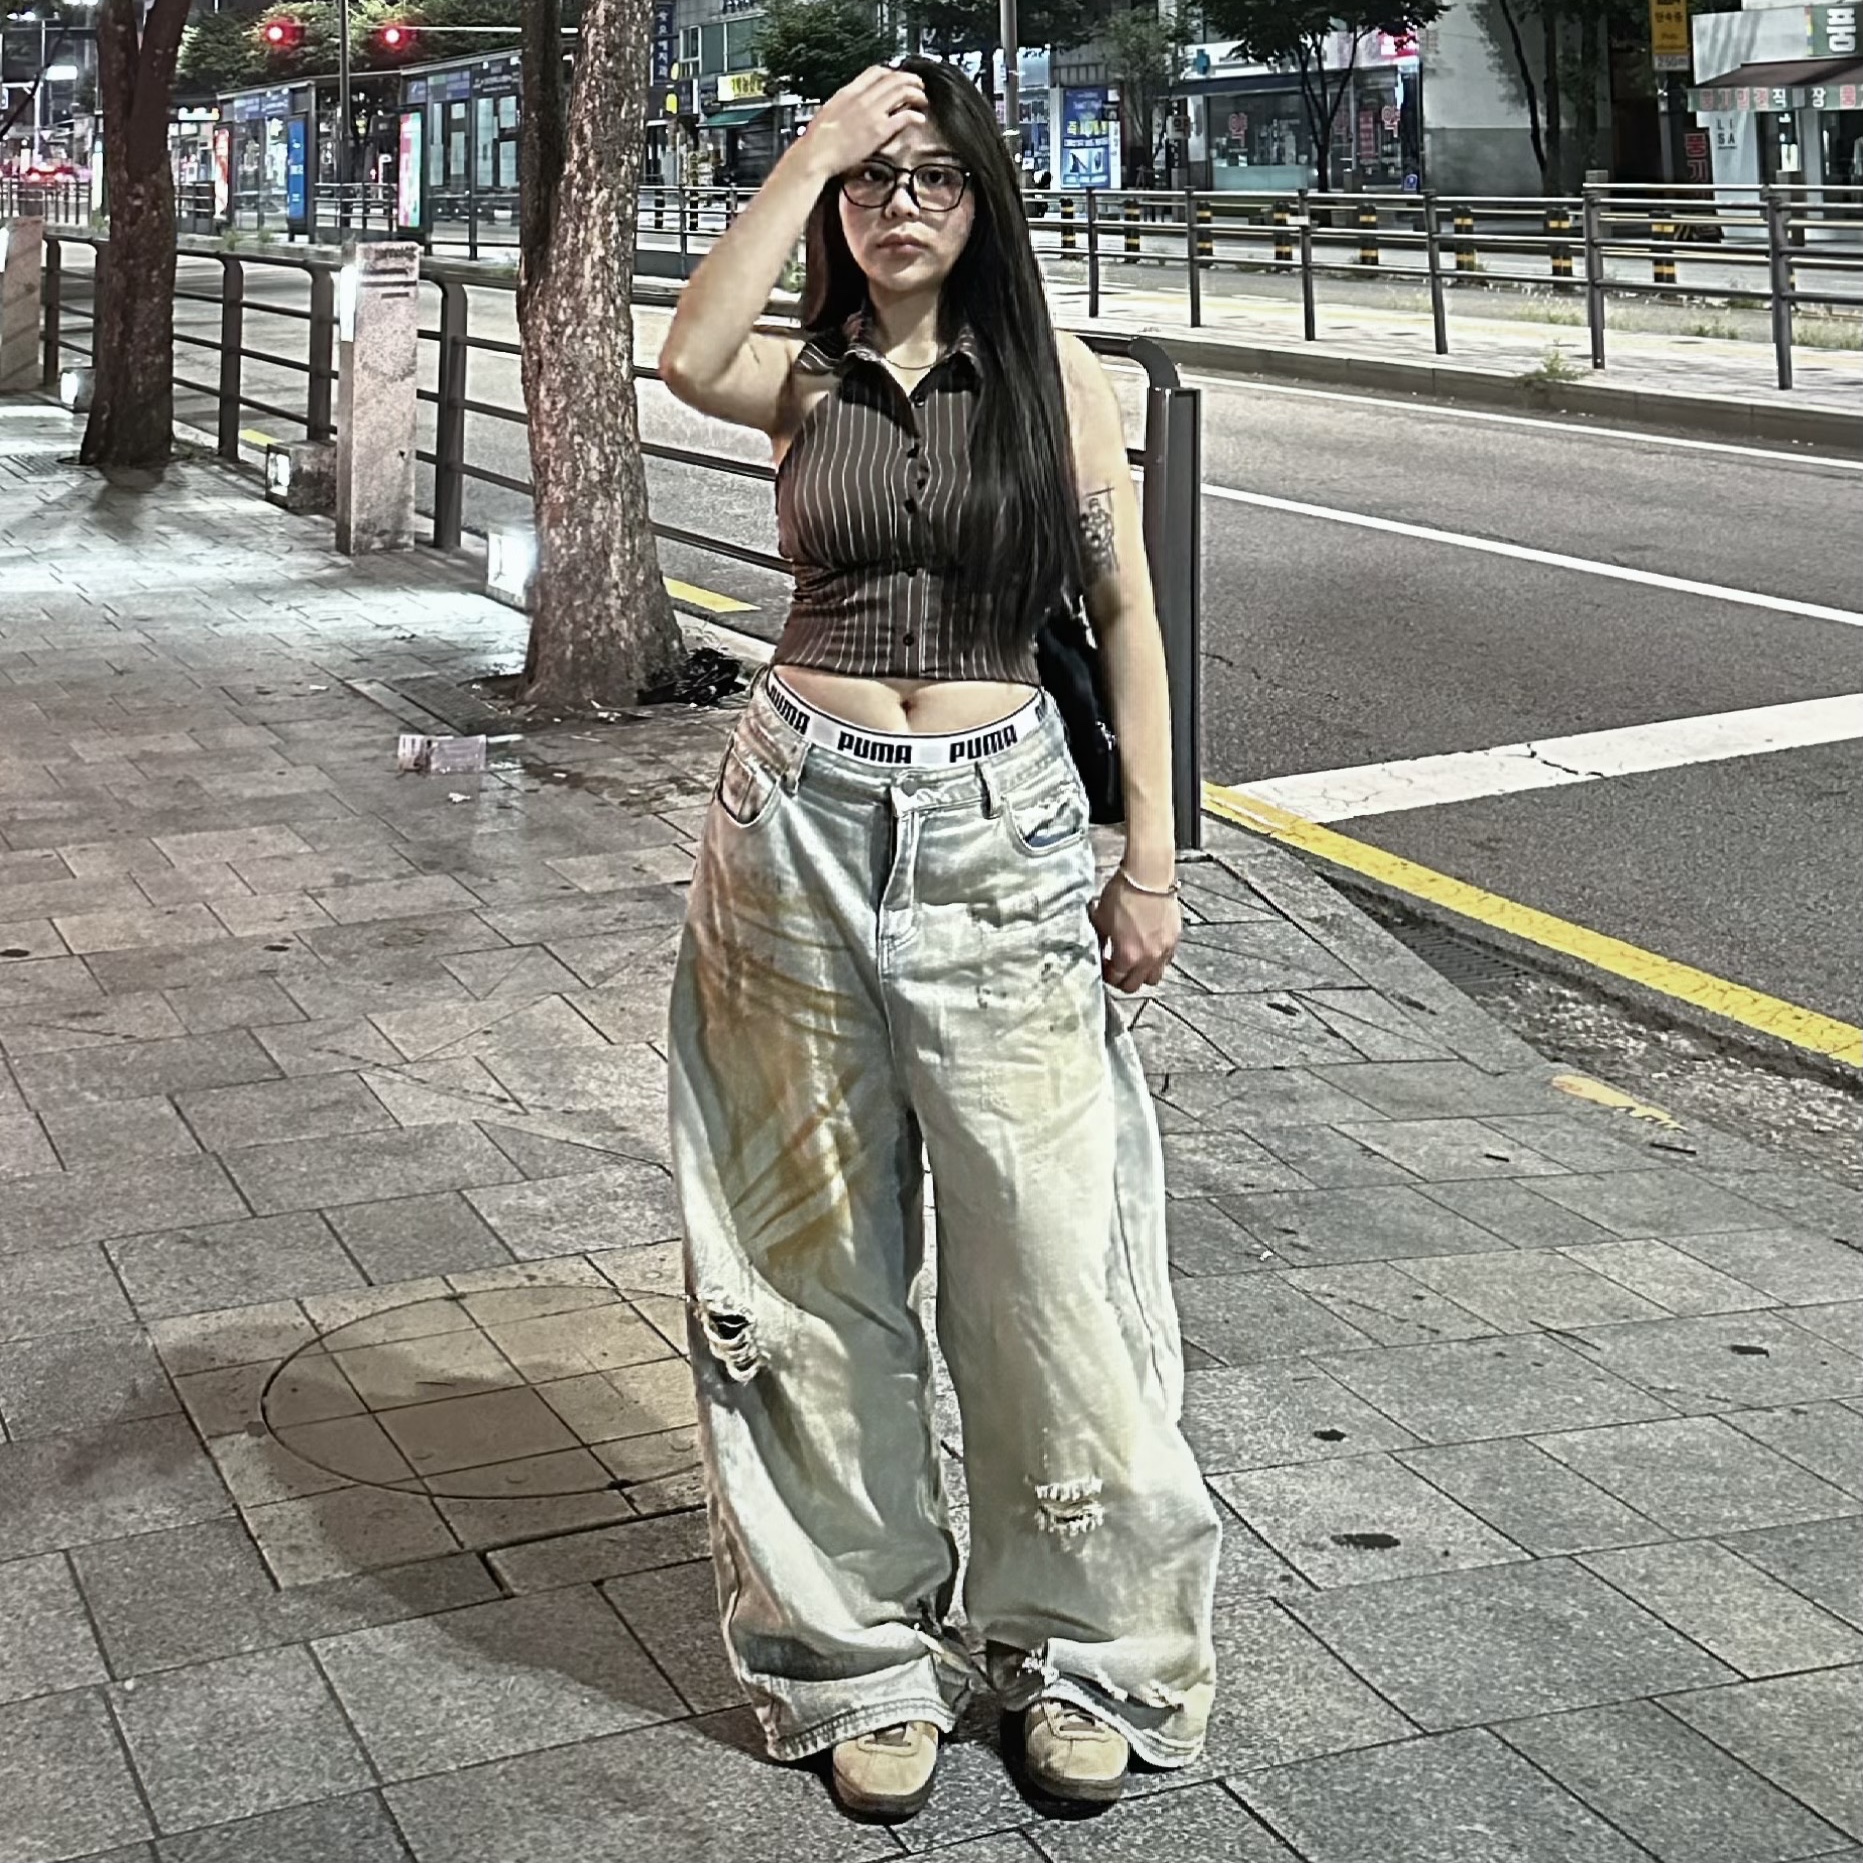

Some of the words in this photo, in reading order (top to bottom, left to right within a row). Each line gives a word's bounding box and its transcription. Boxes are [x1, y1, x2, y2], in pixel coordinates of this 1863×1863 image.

[769, 685, 811, 736] PUMA
[837, 731, 912, 764] PUMA
[950, 724, 1018, 763] PUMA
